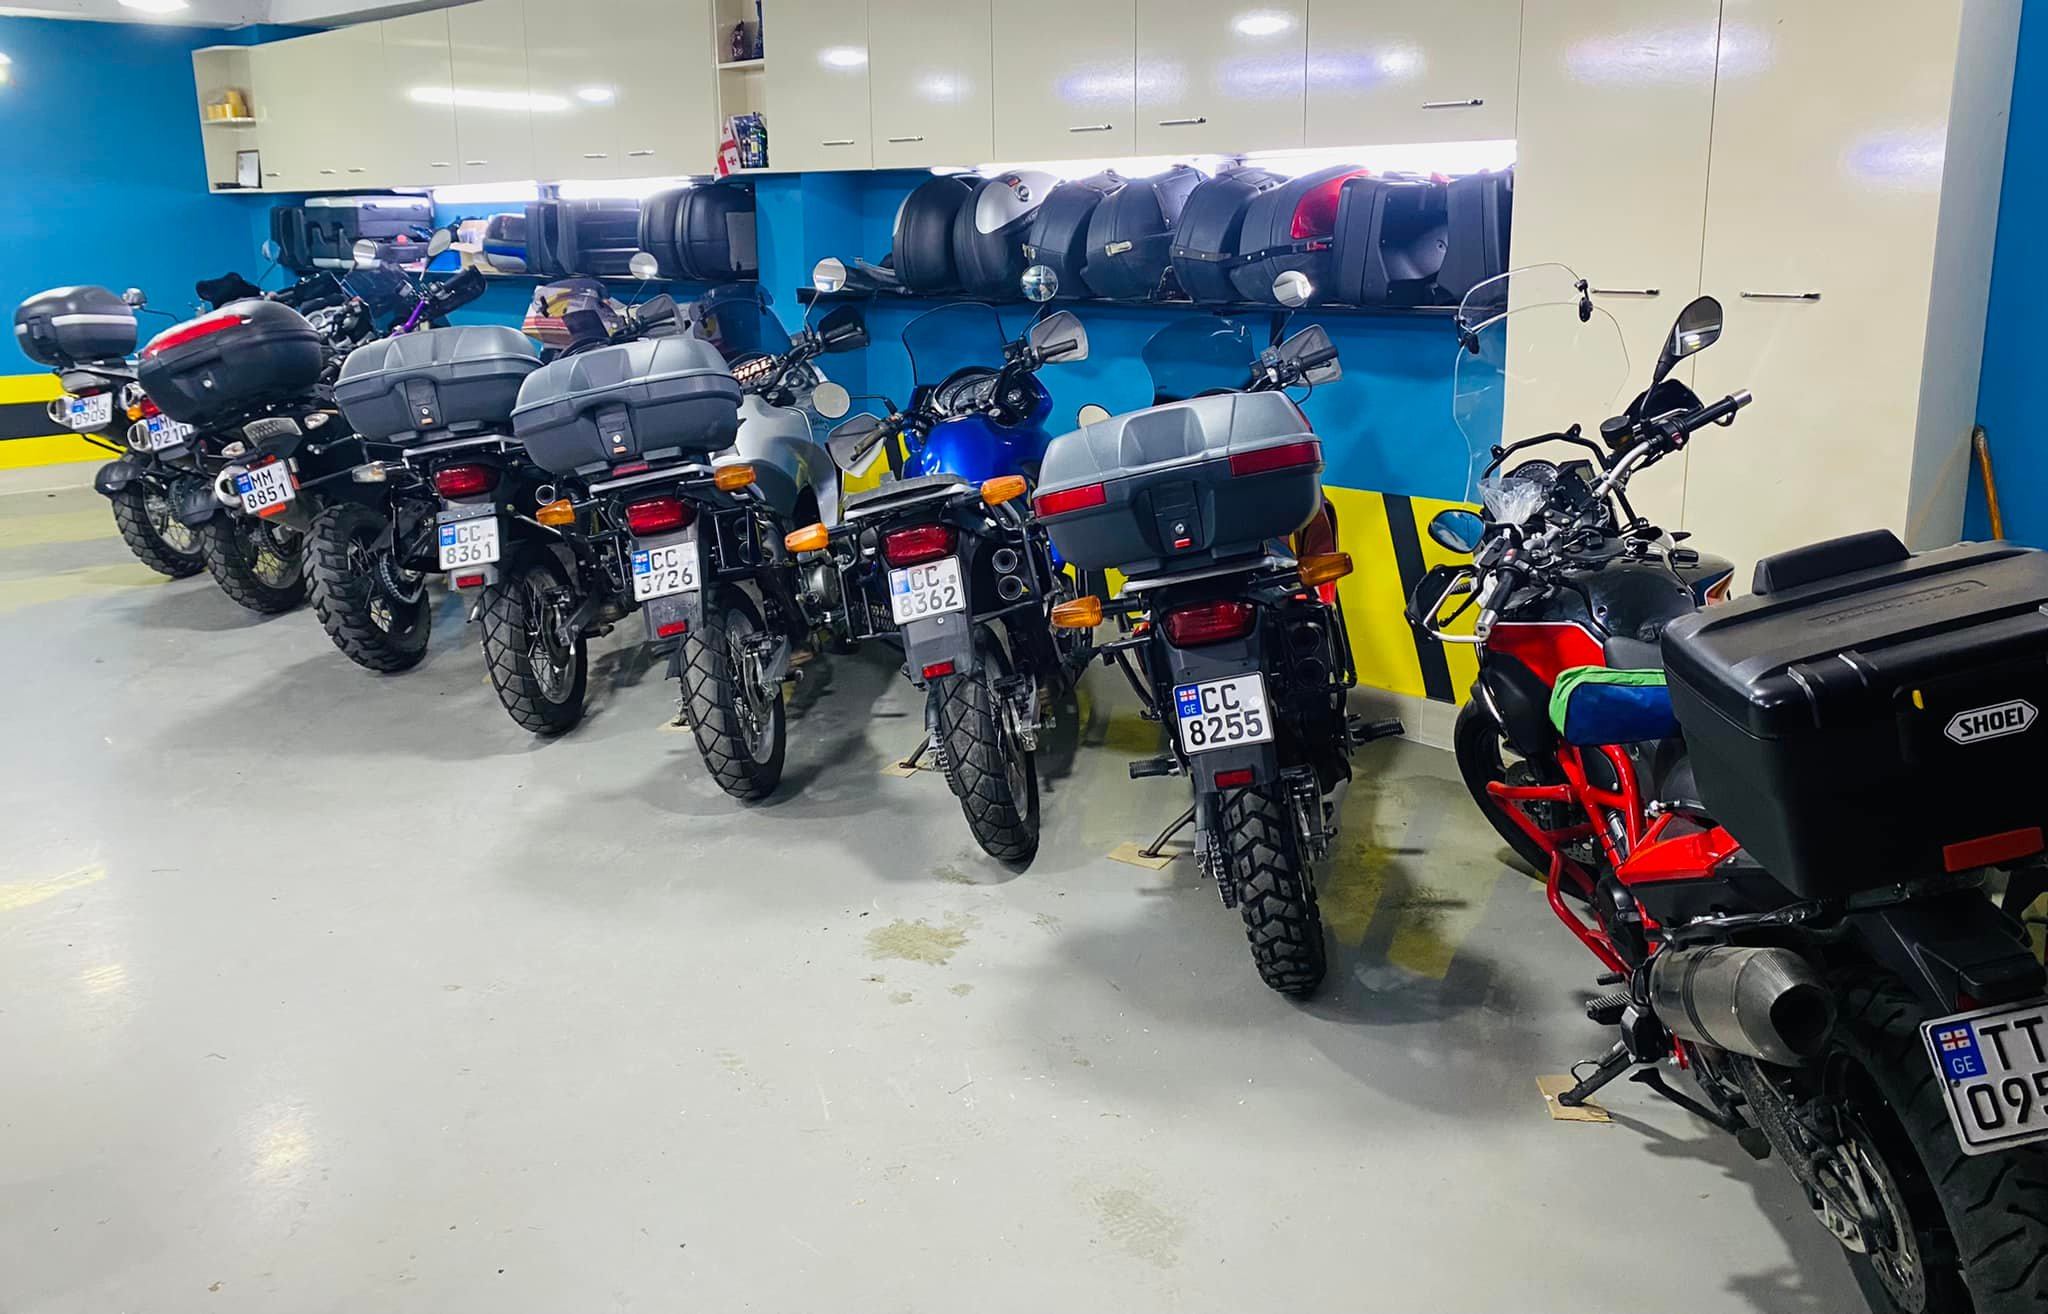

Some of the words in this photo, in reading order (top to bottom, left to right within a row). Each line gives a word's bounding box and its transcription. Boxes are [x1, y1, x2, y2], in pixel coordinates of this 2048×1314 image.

[75, 409, 106, 425] 0908
[250, 469, 274, 489] MM
[247, 483, 287, 508] 8851
[457, 525, 481, 544] CC
[446, 542, 492, 564] 8361
[651, 549, 678, 571] CC
[641, 567, 693, 594] 3726
[911, 566, 940, 591] CC
[901, 586, 958, 617] 8362
[1184, 704, 1197, 715] GE
[1201, 684, 1240, 714] CC
[1189, 709, 1263, 745] 8255
[1959, 707, 2025, 737] SHOEI
[1979, 1016, 2044, 1070] TT
[1952, 1056, 1976, 1074] GE
